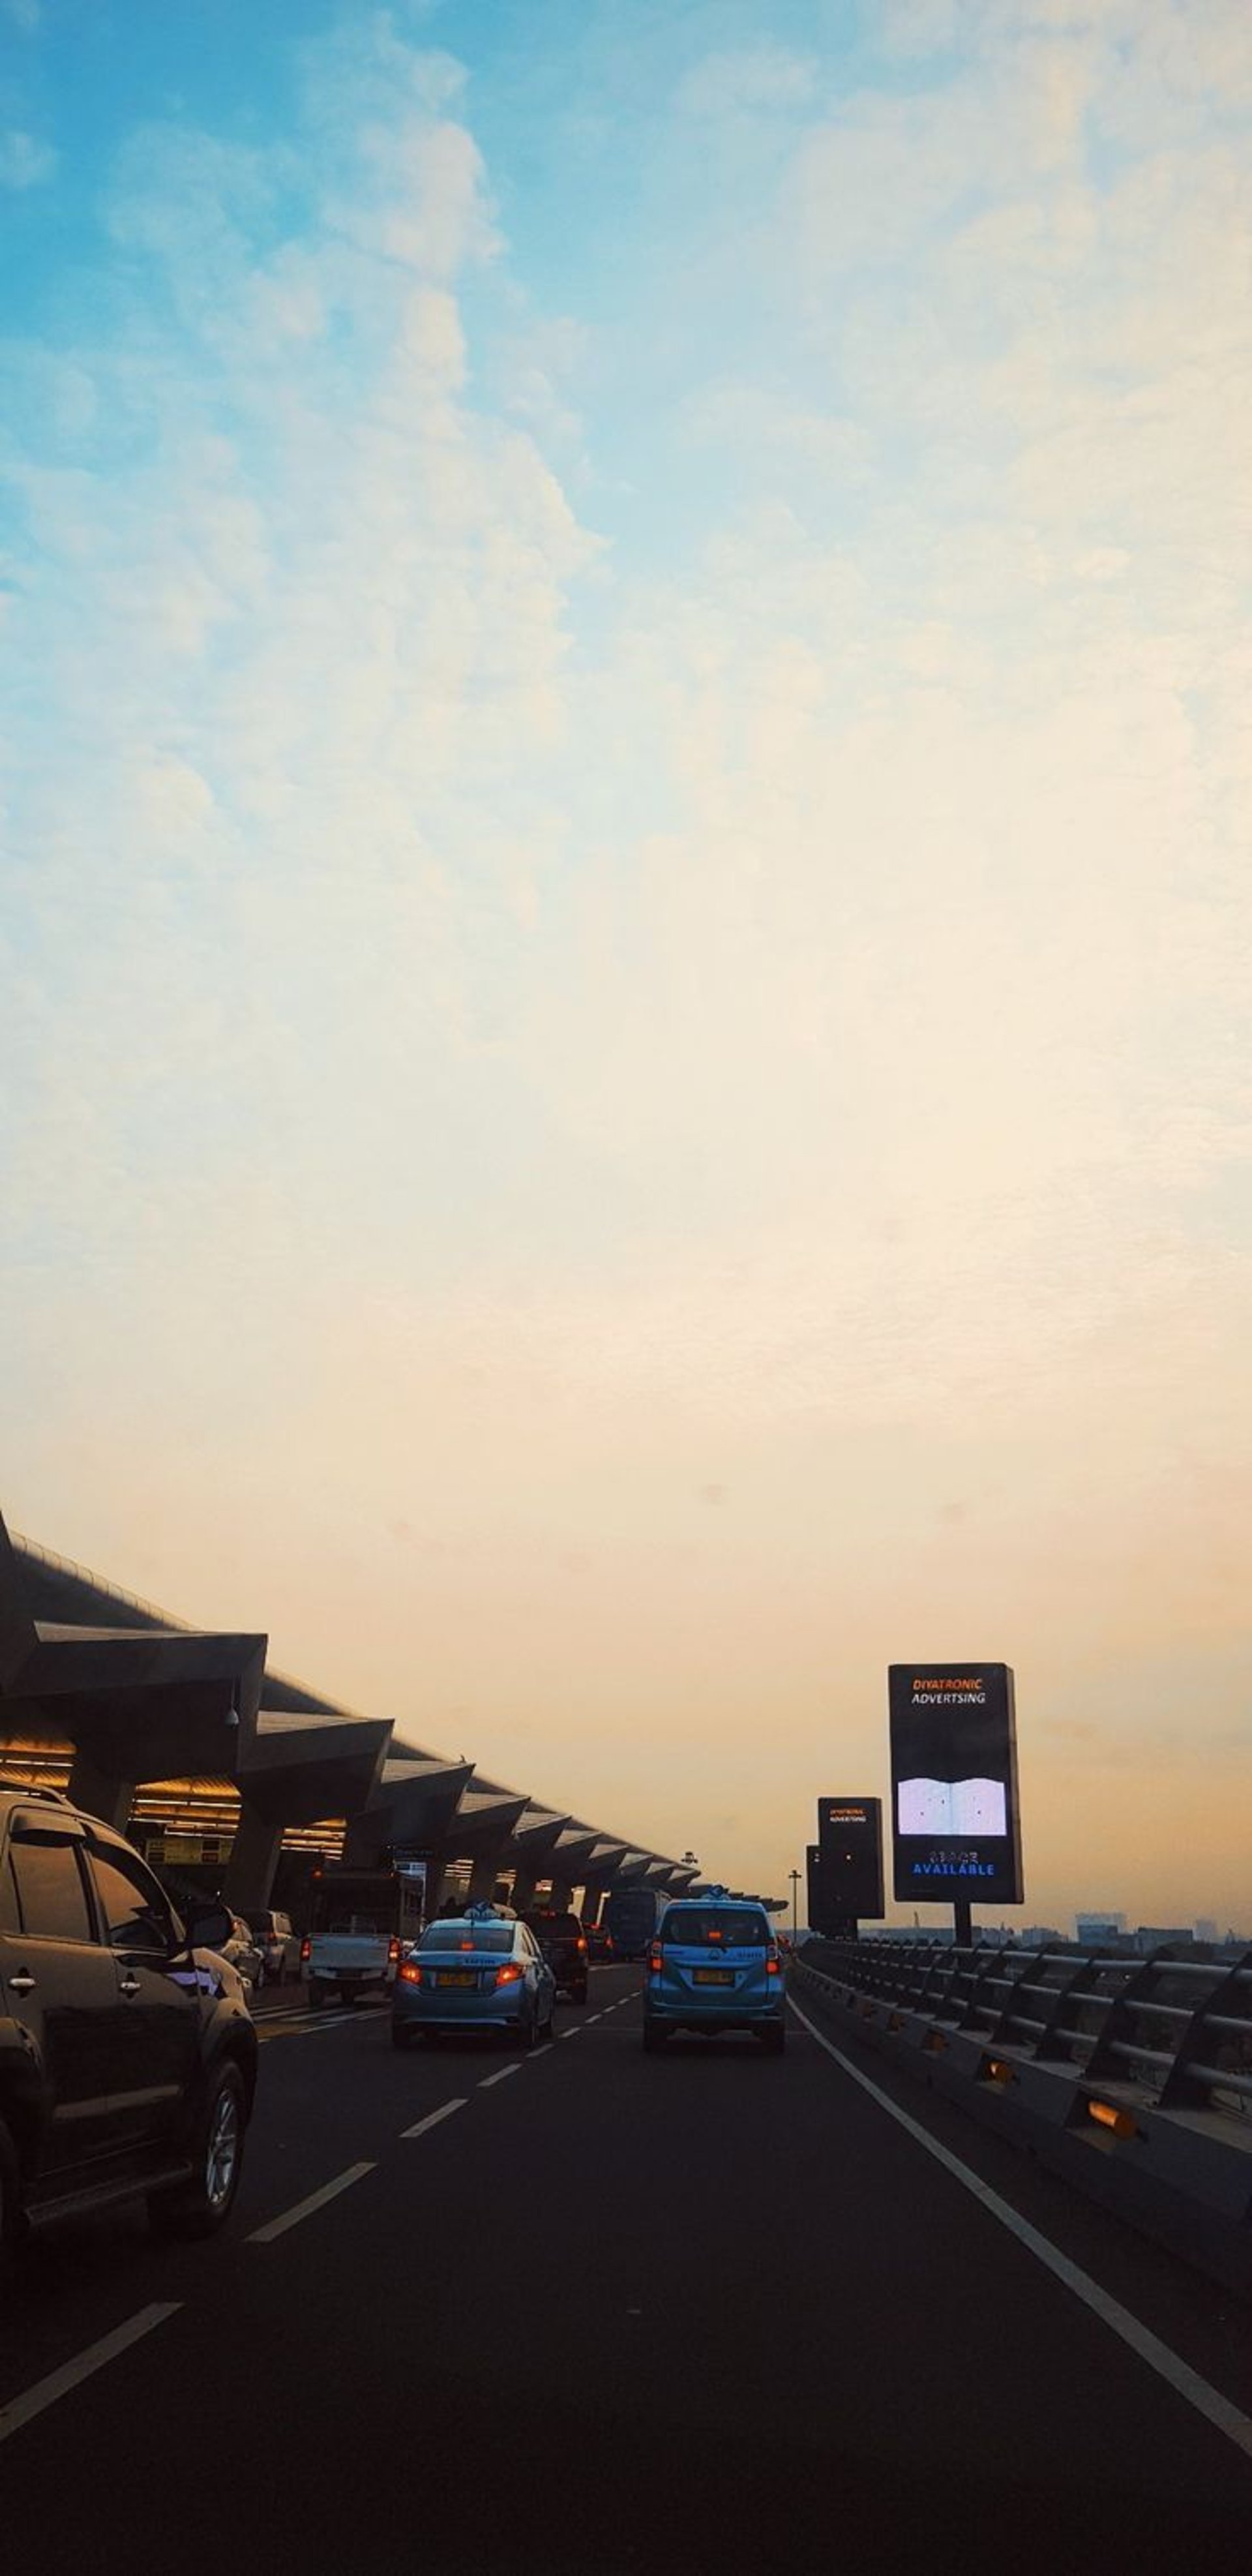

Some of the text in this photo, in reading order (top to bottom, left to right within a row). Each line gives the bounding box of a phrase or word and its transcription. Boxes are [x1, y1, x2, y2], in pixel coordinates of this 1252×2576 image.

[913, 1678, 982, 1690] DIYATRONIC
[912, 1692, 985, 1704] ADVERTSING
[913, 1864, 994, 1875] AVAILABLE
